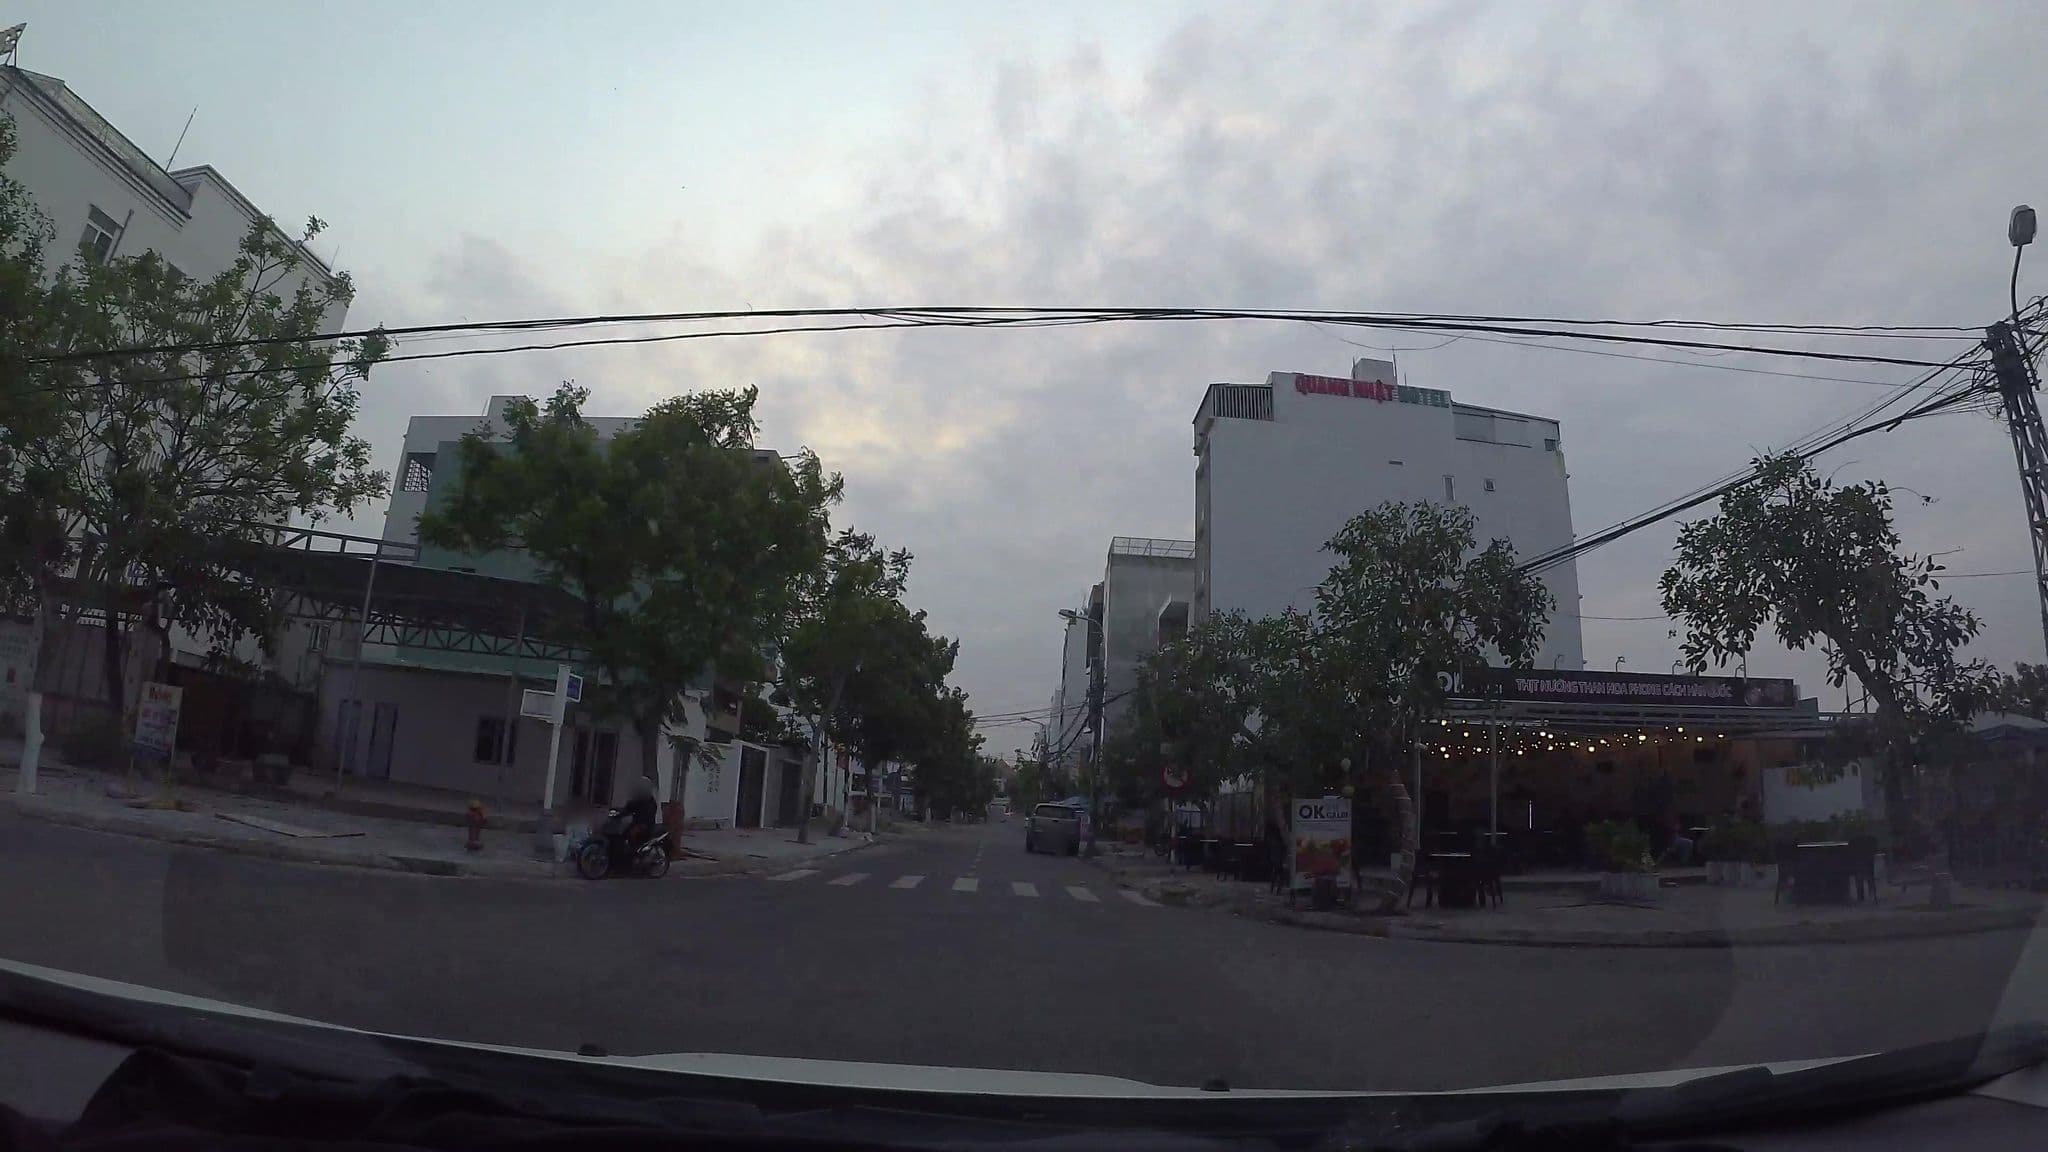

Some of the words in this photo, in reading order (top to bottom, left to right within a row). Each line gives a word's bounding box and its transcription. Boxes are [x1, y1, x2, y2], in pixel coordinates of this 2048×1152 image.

[1296, 374, 1348, 395] QUANG
[1515, 679, 1539, 694] THỊT
[1578, 681, 1606, 695] THAN
[1606, 682, 1626, 696] HOA
[1628, 682, 1661, 696] PHONG
[1299, 805, 1325, 819] OK
